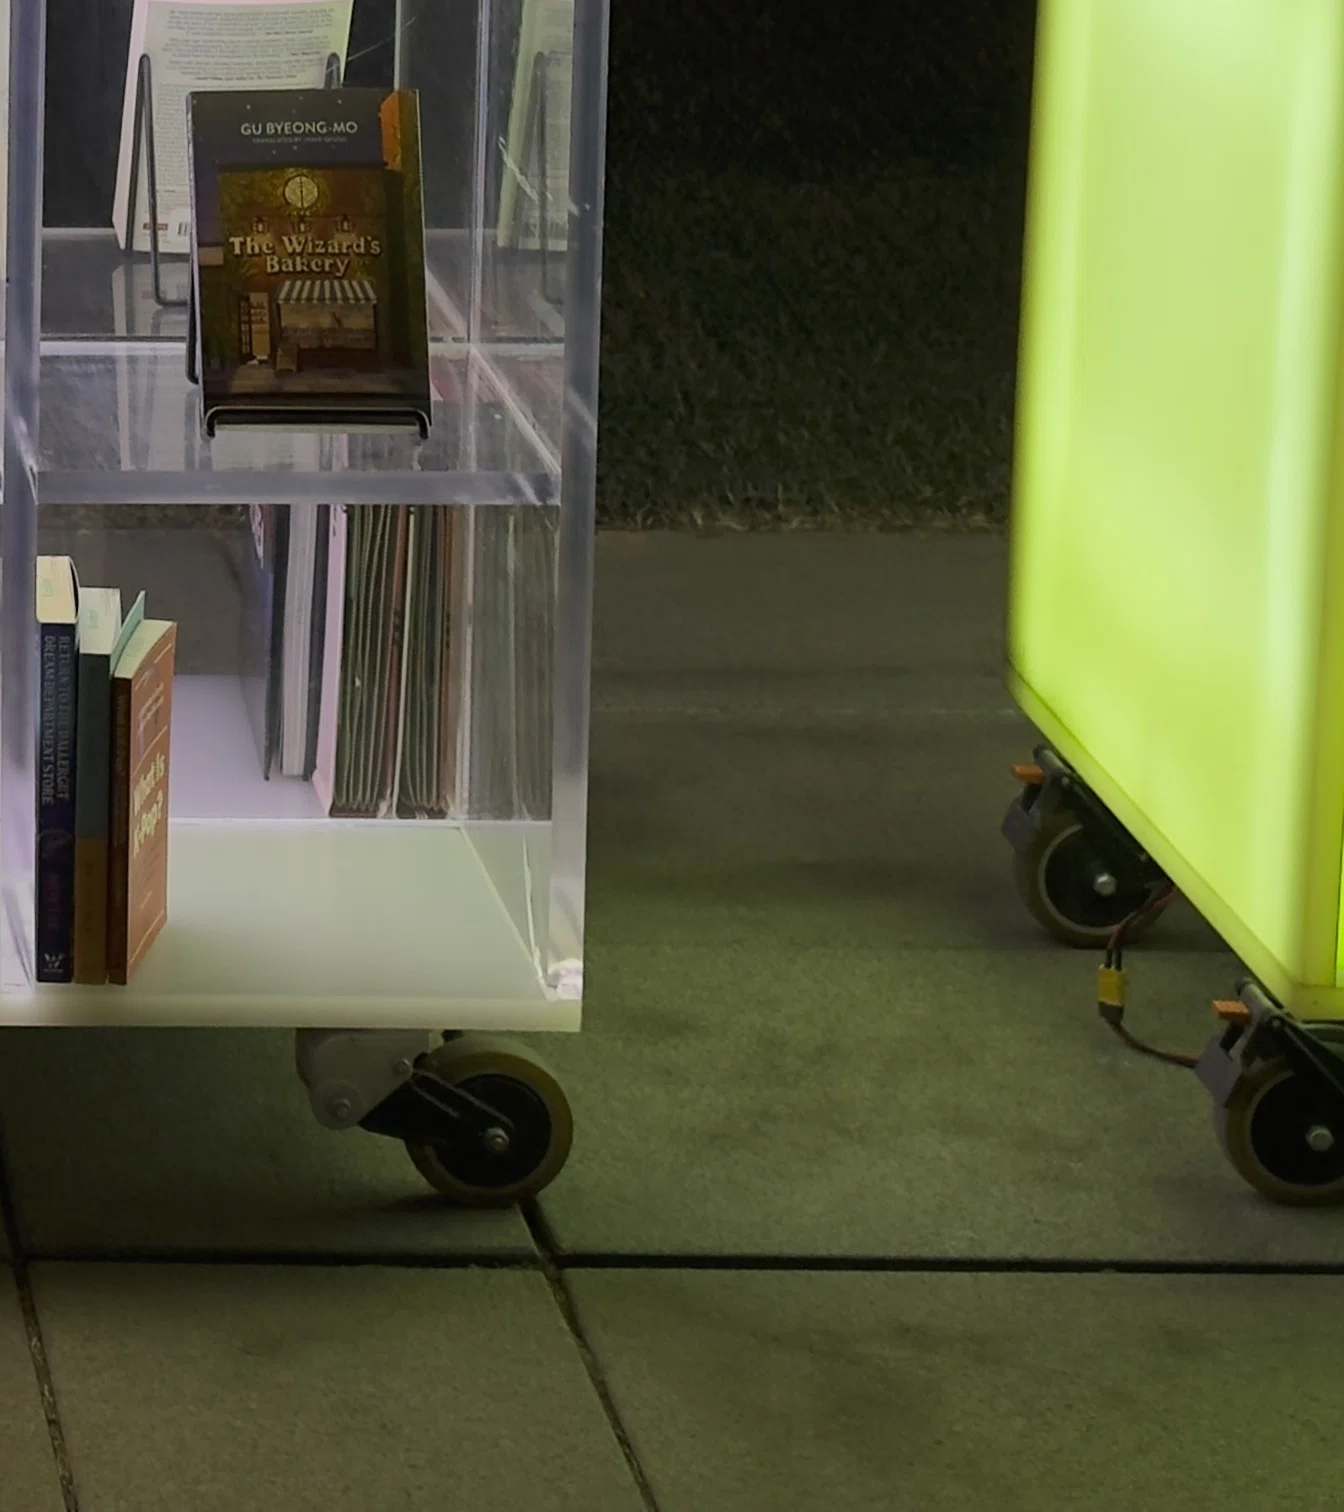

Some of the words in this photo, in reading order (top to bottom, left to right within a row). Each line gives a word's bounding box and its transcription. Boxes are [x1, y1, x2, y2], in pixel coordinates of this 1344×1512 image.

[240, 122, 263, 136] GU
[266, 120, 358, 136] BYEONG-MO
[228, 236, 276, 256] The
[281, 235, 382, 256] Wizard's
[265, 254, 352, 277] Bakery
[40, 763, 55, 805] STORE
[133, 760, 156, 817] What
